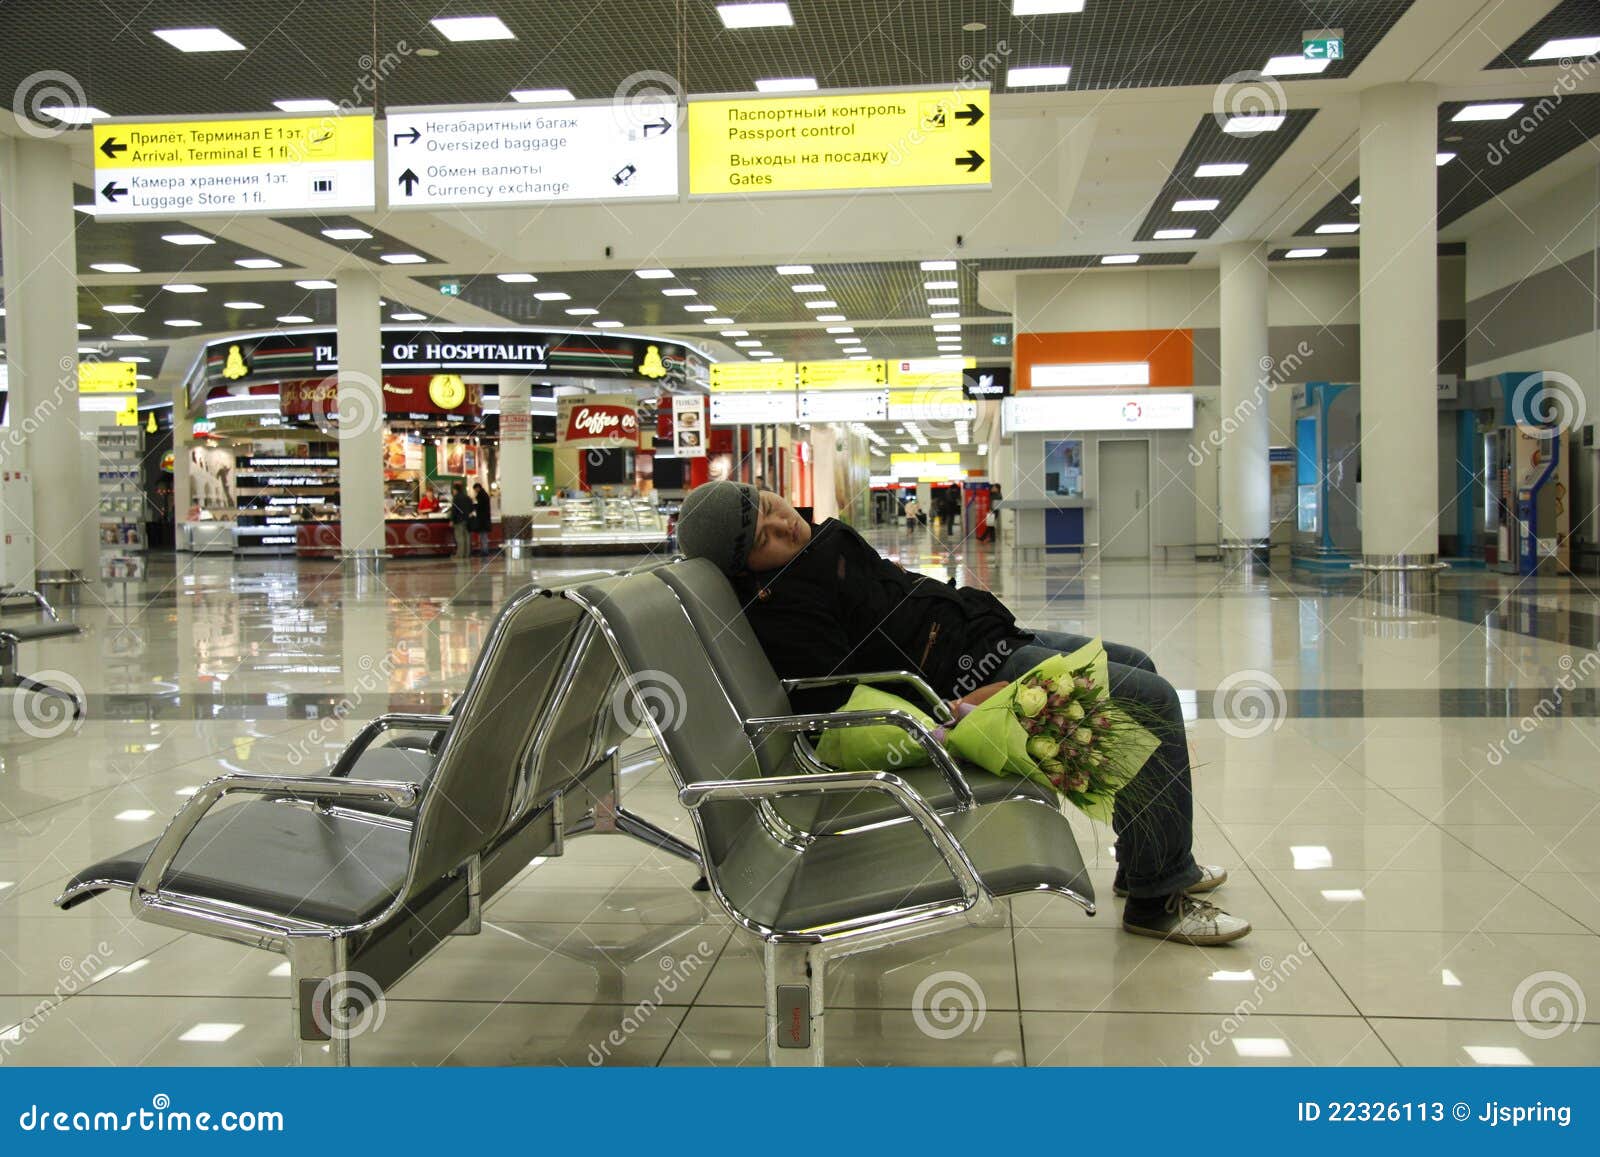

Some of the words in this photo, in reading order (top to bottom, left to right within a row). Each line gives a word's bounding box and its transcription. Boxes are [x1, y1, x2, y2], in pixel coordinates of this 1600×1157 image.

[729, 105, 826, 122] Паспортный
[832, 105, 906, 119] контроль
[426, 119, 531, 135] Негабаритный
[536, 117, 578, 130] багаж
[729, 127, 796, 141] Passport
[801, 123, 855, 137] control
[130, 131, 186, 146] Прилёт,
[190, 129, 260, 145] Терминал
[427, 138, 499, 152] Oversized
[504, 137, 567, 152] baggage
[132, 149, 183, 163] Arrival,
[188, 147, 247, 161] Terminal
[252, 147, 262, 159] E
[268, 147, 275, 158] 1
[730, 152, 796, 167] Выходы
[801, 152, 819, 164] на
[824, 151, 888, 164] посадку
[427, 165, 476, 178] Обмен
[482, 164, 542, 176] валюты
[729, 172, 772, 186] Gates
[131, 175, 185, 189] Камера
[190, 173, 259, 188] хранения
[427, 184, 494, 198] Currency
[499, 180, 570, 195] exchange
[132, 194, 193, 209] Luggage
[198, 192, 236, 205] Store
[242, 191, 248, 203] 1
[393, 344, 420, 360] OF
[426, 343, 547, 361] HOSPITALITY
[575, 408, 619, 434] Coffee
